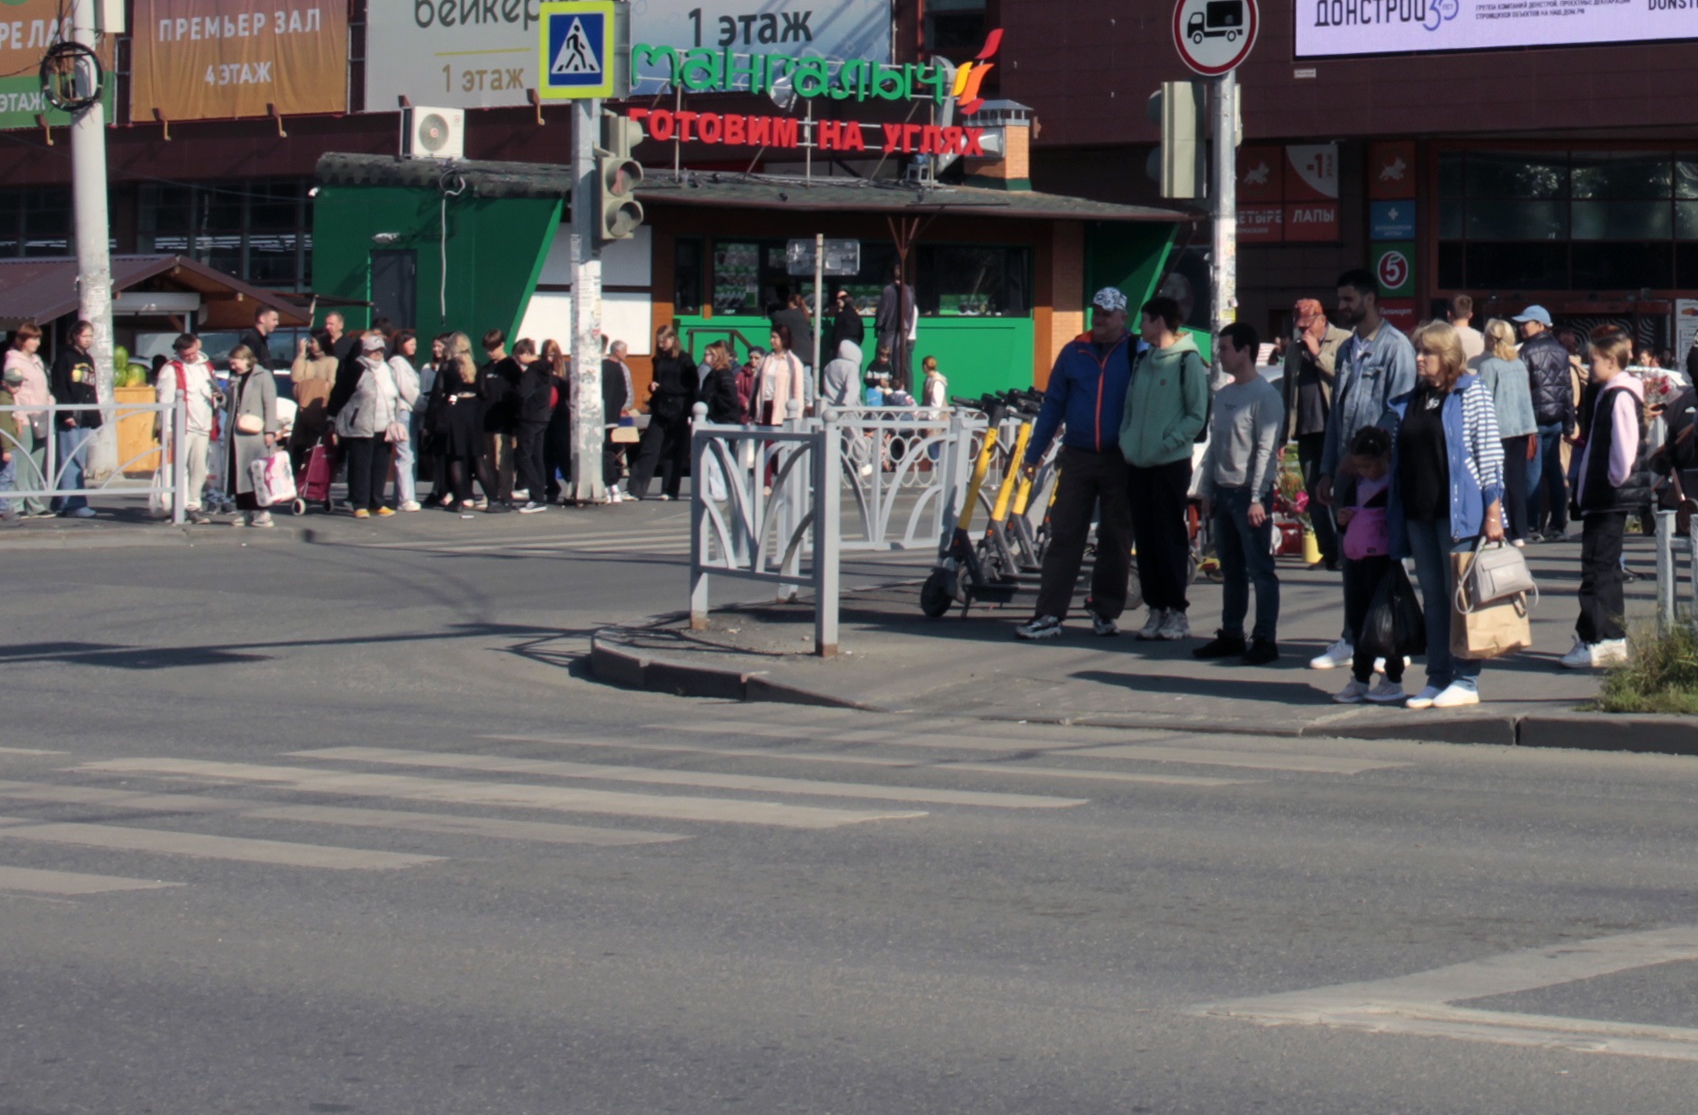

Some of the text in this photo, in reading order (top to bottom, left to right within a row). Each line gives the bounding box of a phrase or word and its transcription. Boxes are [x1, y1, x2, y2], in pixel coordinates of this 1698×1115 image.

[159, 8, 321, 42] ПРЕМЬЕР ЗАЛ
[688, 8, 813, 48] 1 этаж
[204, 61, 271, 85] 4 ЭТАЖ
[442, 65, 524, 91] 1 этаж
[631, 43, 948, 105] мангалыч
[627, 107, 984, 156] ГОТОВИМ НА УГЛЯХ
[1235, 209, 1335, 224] ЕТЫРЕ ЛАПЫ
[1384, 255, 1401, 282] 5
